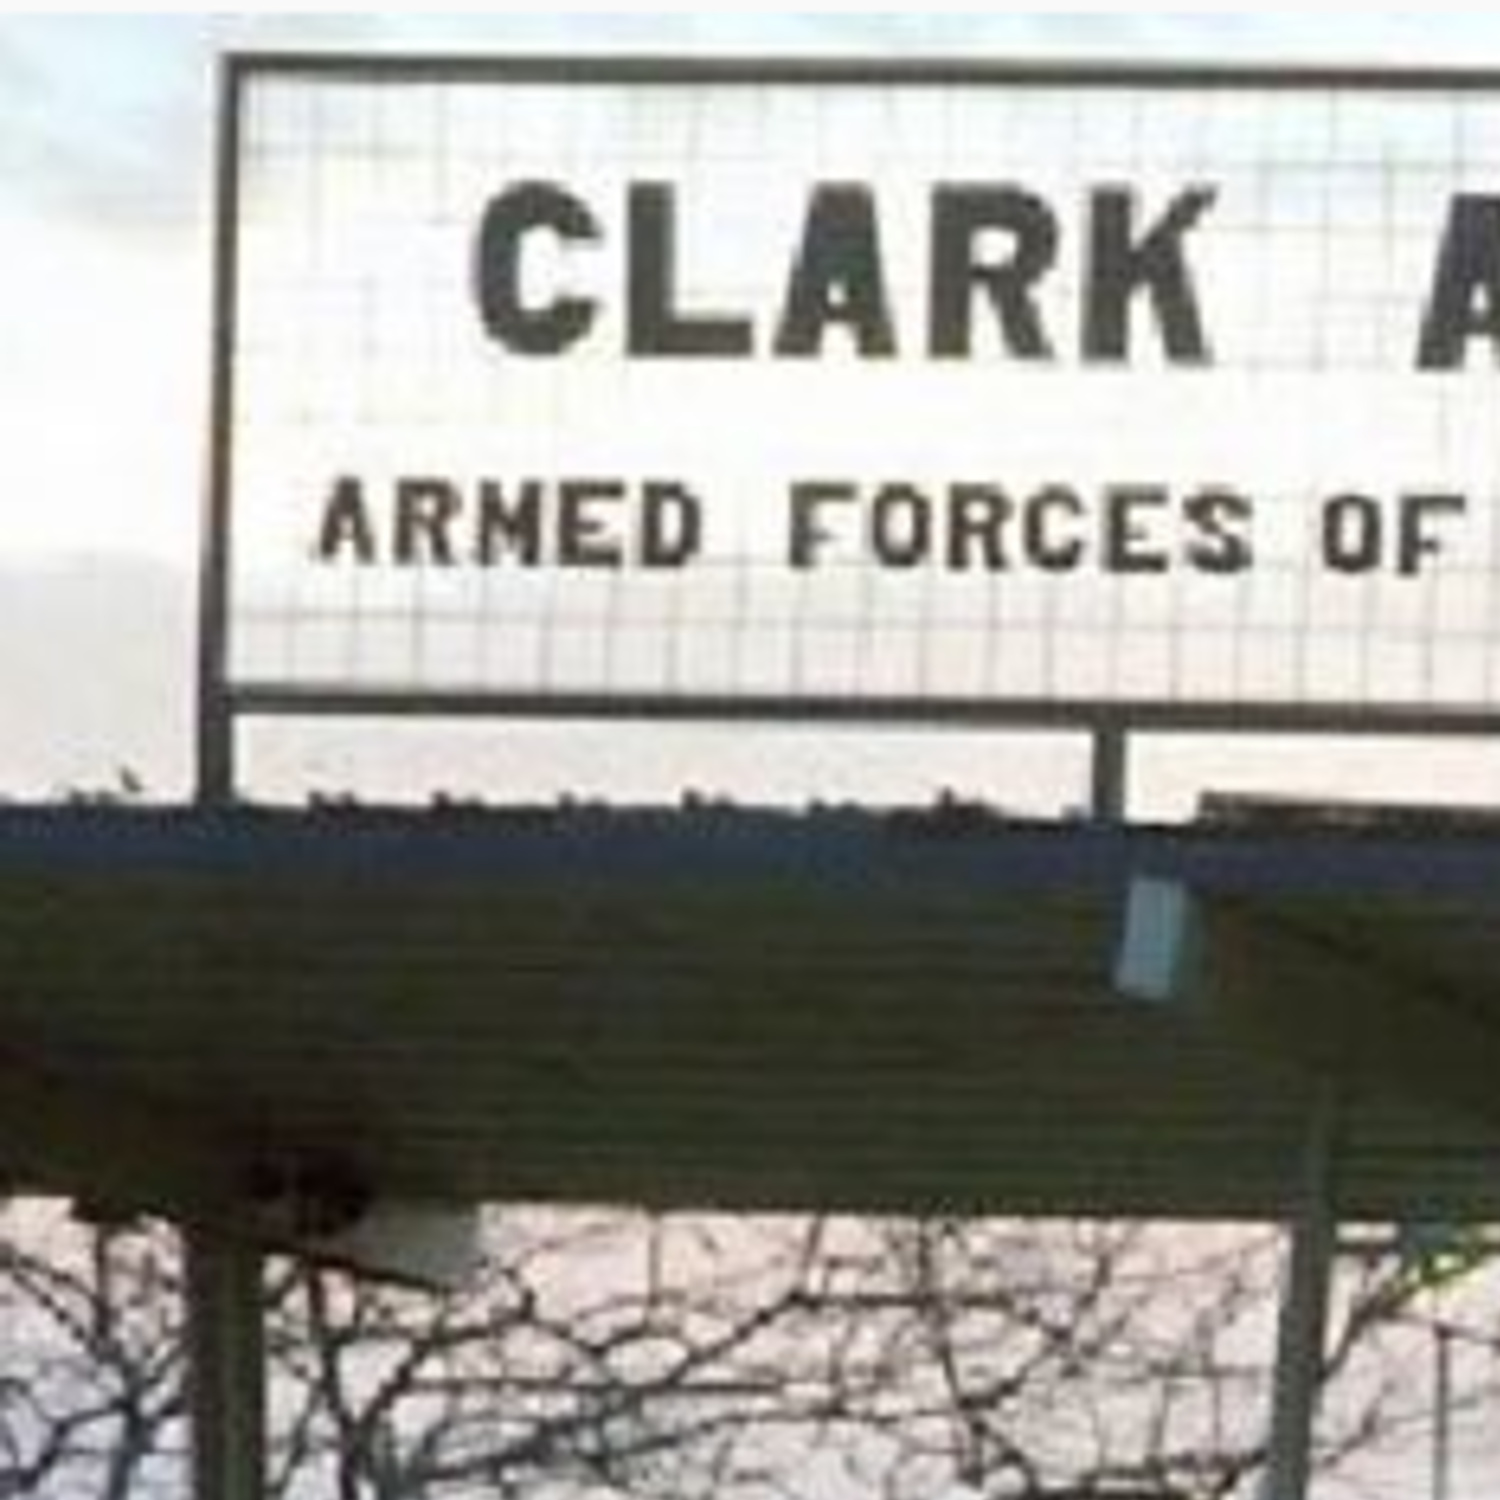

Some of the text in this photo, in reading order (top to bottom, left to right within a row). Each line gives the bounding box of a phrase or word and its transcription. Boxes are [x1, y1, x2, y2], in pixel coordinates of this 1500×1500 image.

[471, 181, 1216, 360] CLARK
[318, 478, 703, 570] ARMED
[788, 482, 1254, 576] FORCES
[1321, 492, 1467, 577] OF
